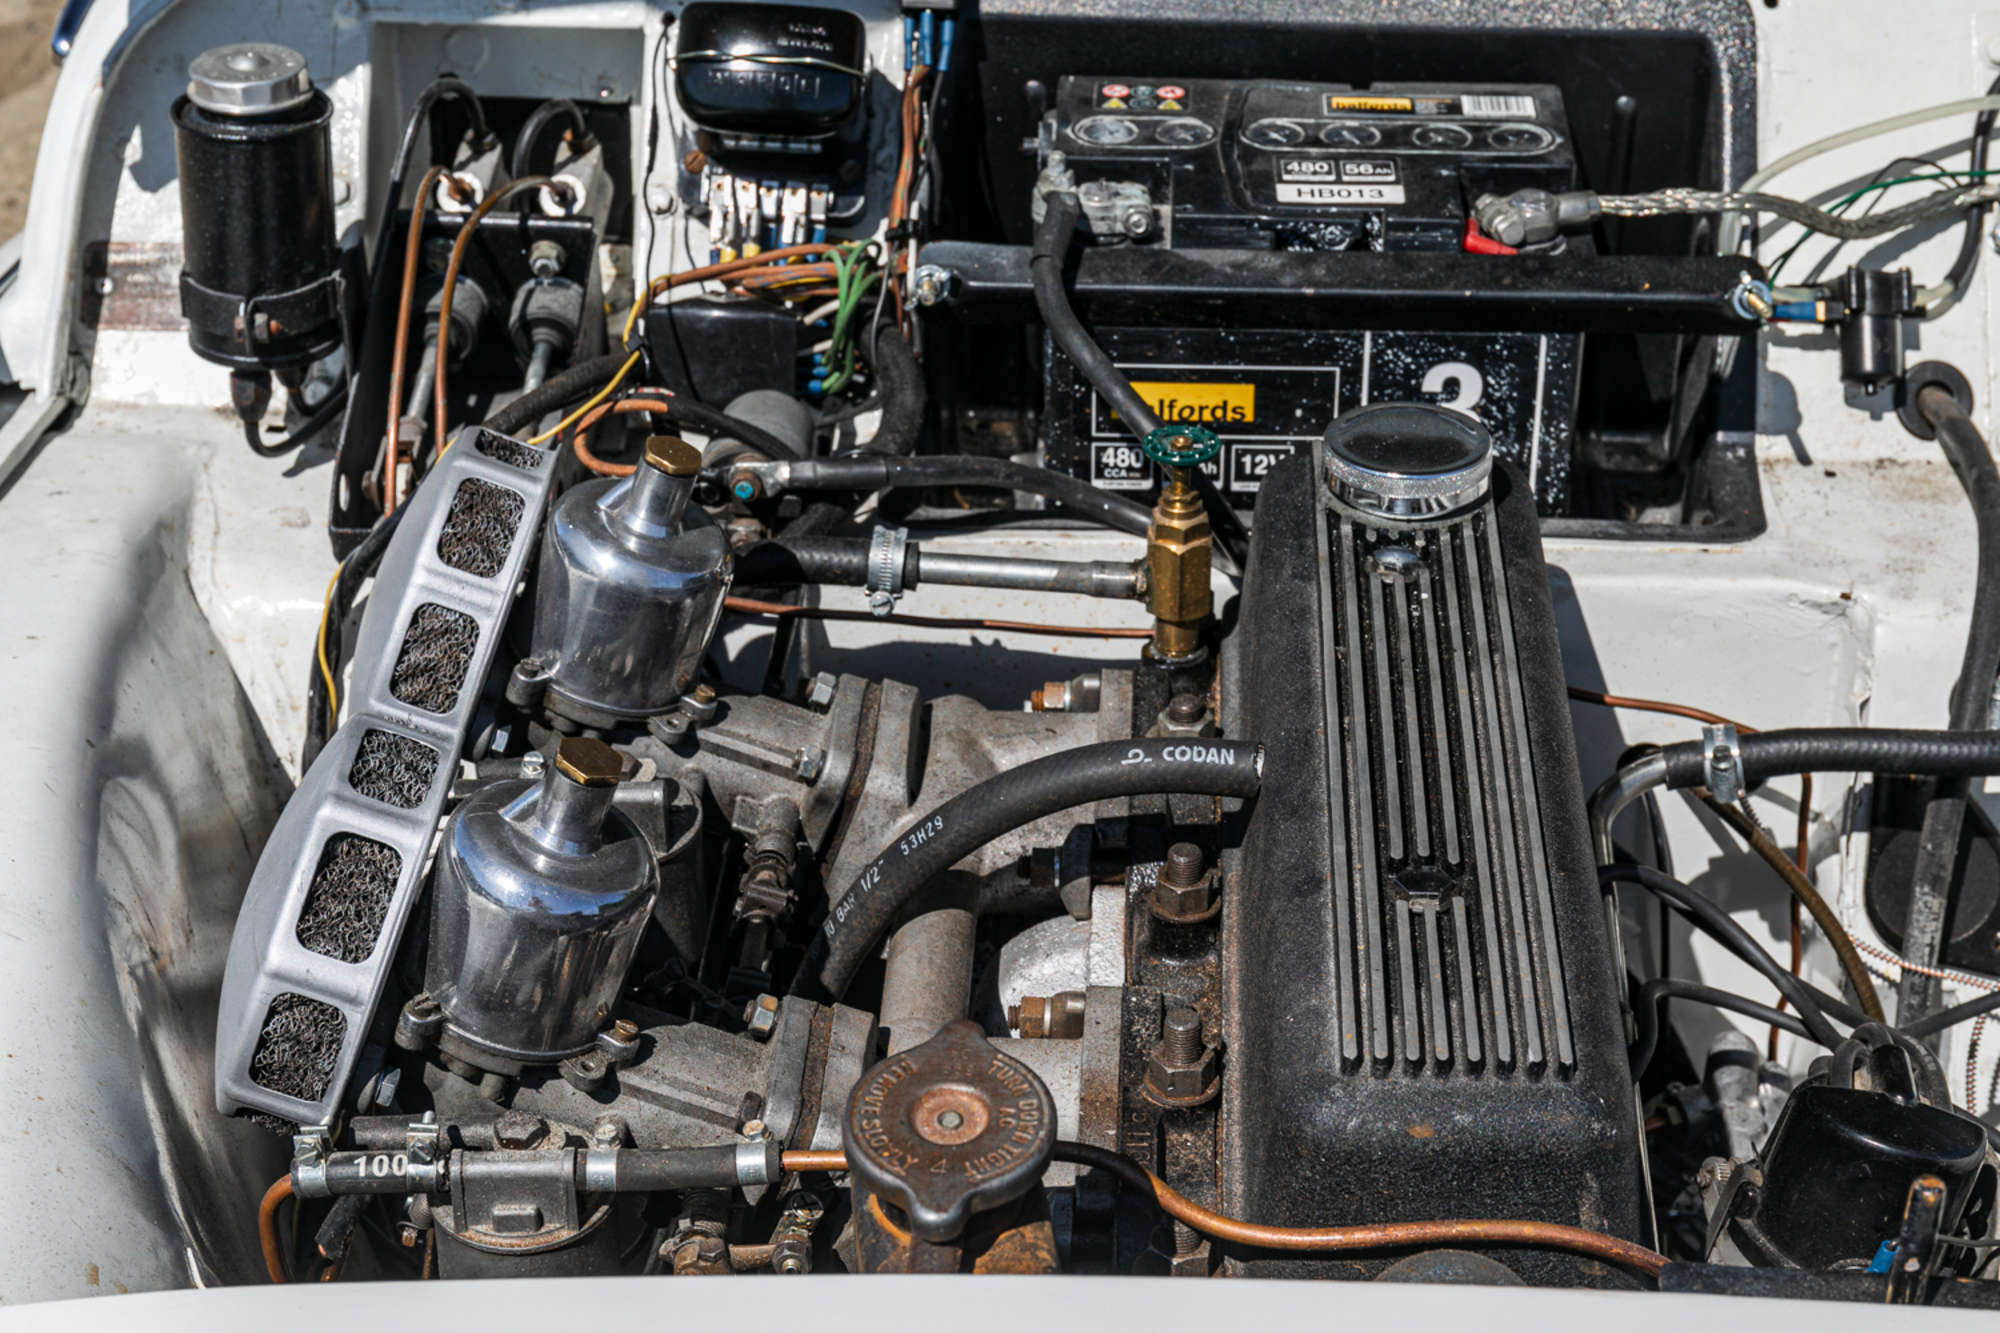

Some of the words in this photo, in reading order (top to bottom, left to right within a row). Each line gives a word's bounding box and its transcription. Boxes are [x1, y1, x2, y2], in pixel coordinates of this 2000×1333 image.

[1286, 161, 1329, 174] 480
[1297, 187, 1384, 199] HB013
[1101, 447, 1144, 468] 480
[1104, 468, 1128, 478] CCA
[1162, 745, 1235, 765] CODAN
[900, 815, 944, 855] 53H29
[353, 1154, 408, 1178] 100
